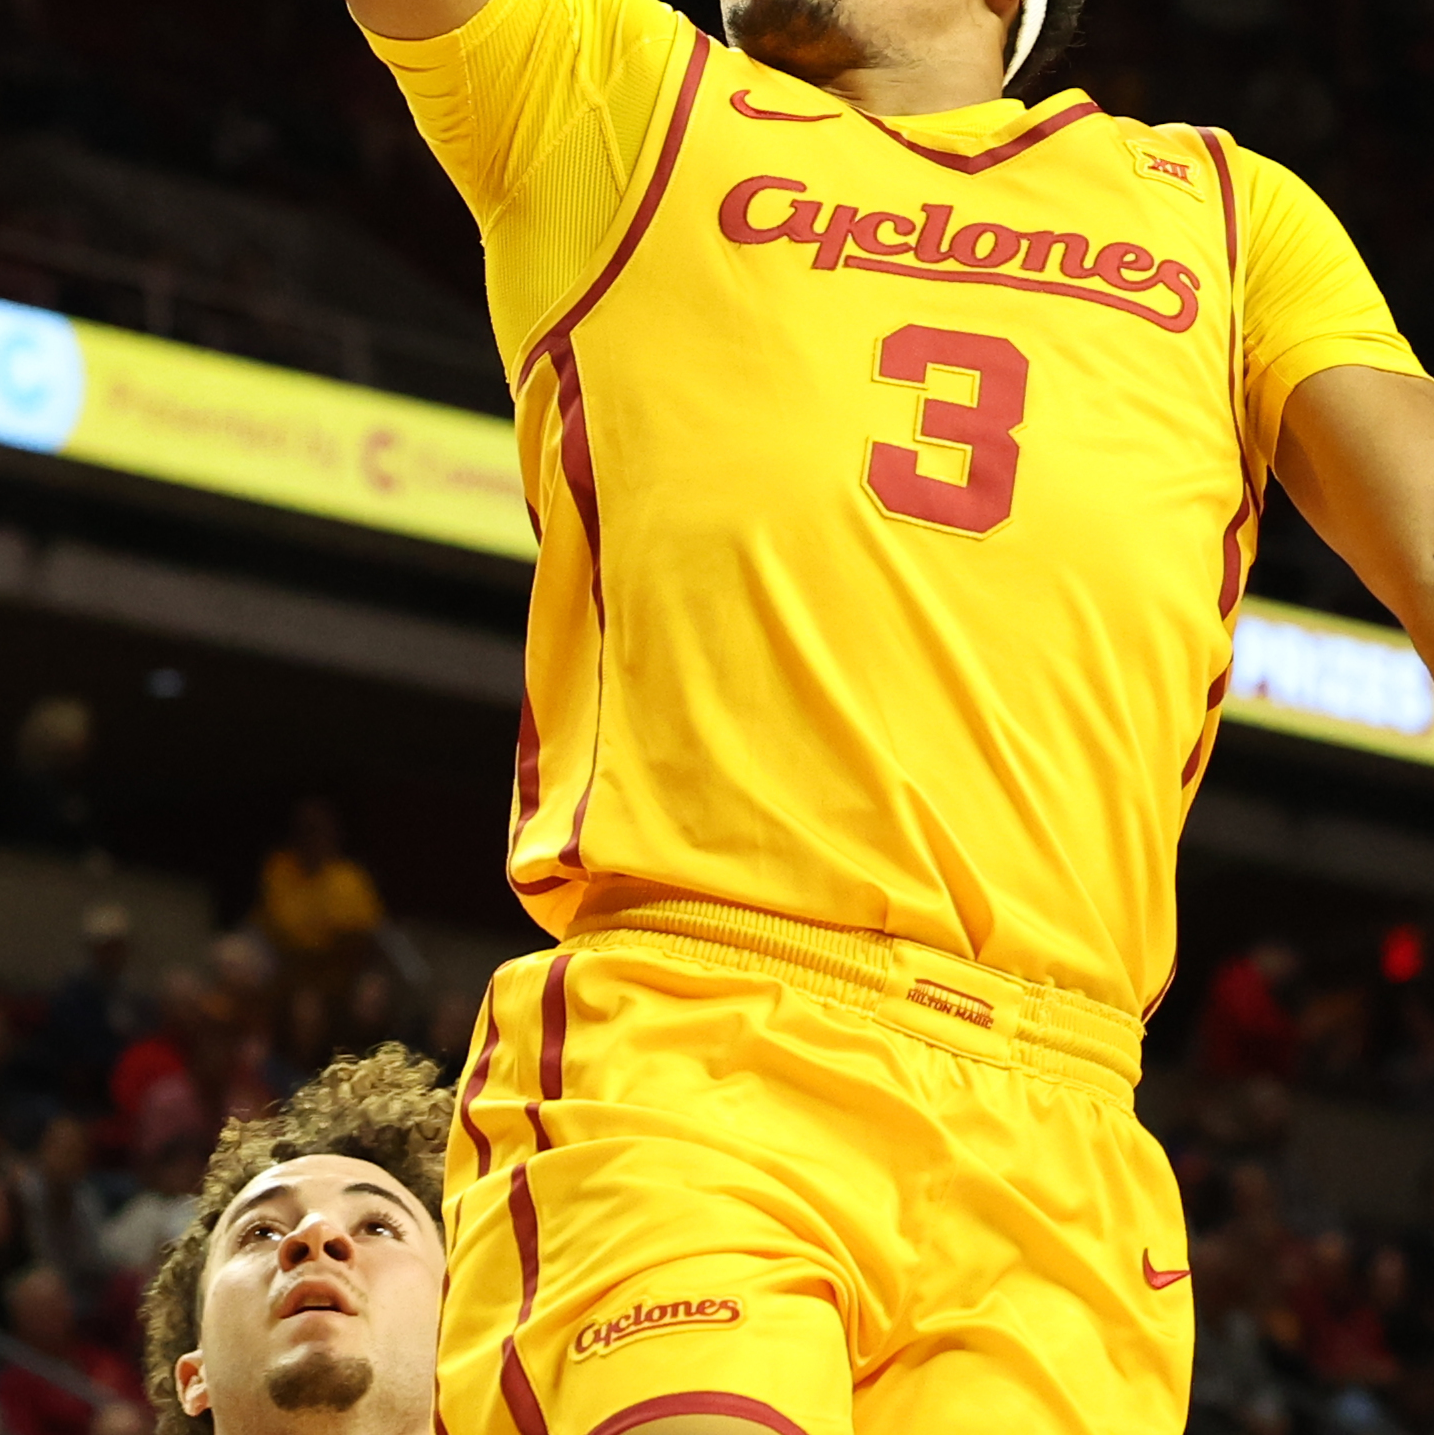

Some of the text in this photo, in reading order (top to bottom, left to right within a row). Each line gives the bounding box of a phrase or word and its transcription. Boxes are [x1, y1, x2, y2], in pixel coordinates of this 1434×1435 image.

[718, 175, 1200, 332] Cyclones
[861, 324, 1029, 540] 3
[906, 989, 994, 1030] HILTON MAGIC
[574, 1298, 741, 1353] Cyclones
